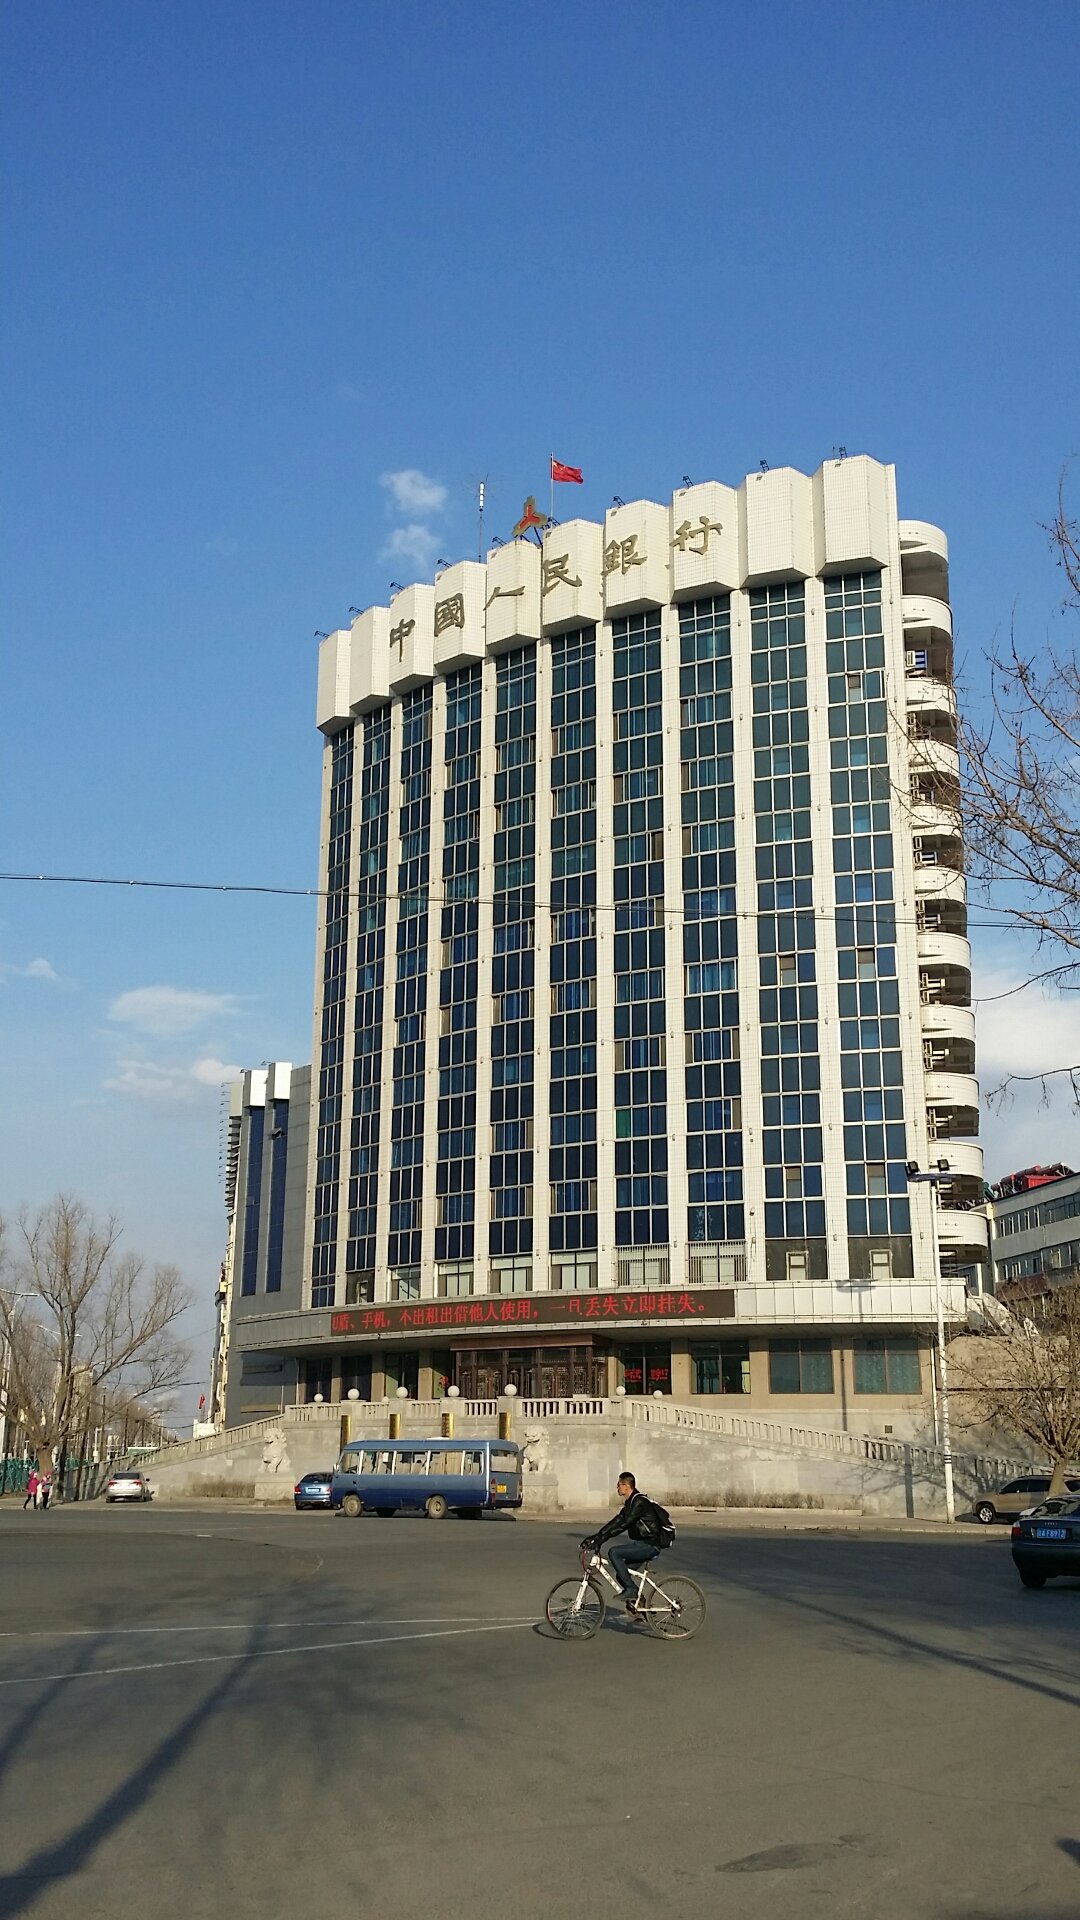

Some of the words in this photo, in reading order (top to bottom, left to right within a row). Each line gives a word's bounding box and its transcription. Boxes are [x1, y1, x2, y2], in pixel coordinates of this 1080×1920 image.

[389, 516, 723, 662] 中國人民銀行
